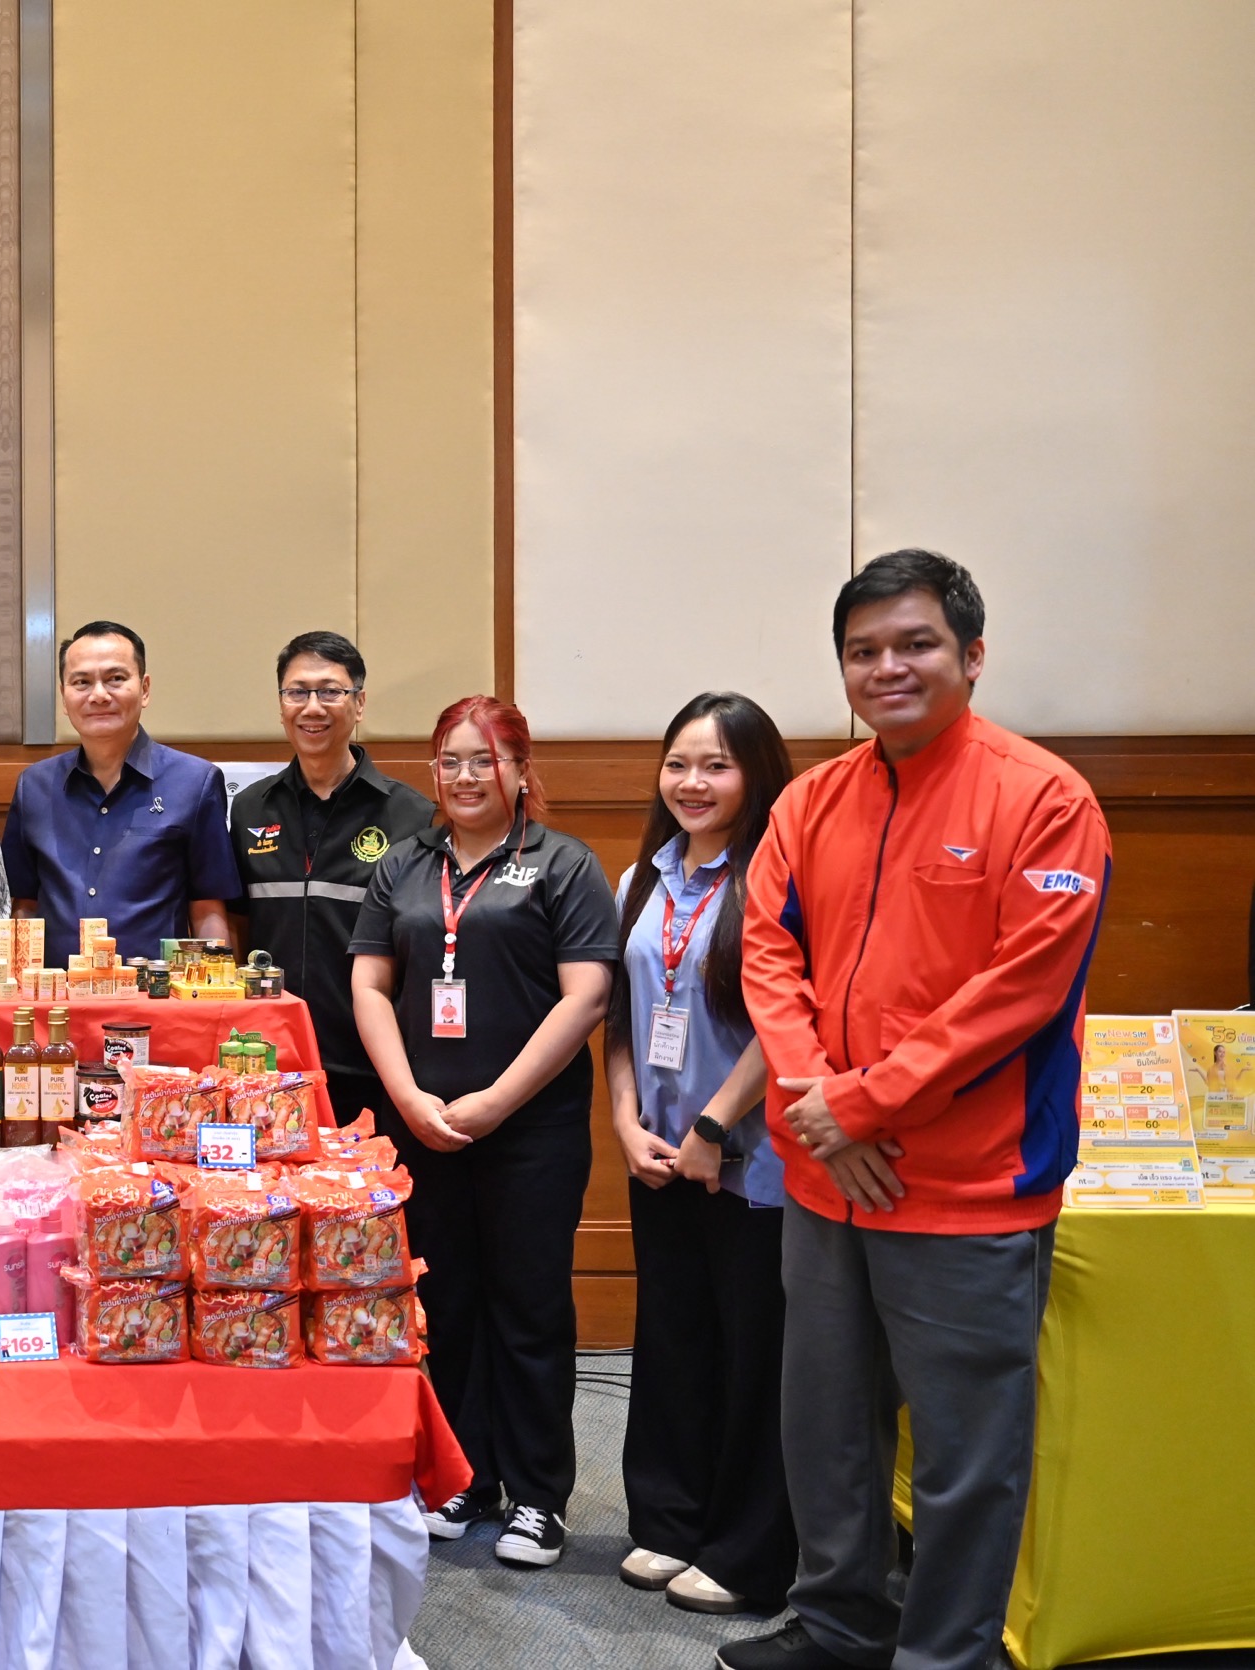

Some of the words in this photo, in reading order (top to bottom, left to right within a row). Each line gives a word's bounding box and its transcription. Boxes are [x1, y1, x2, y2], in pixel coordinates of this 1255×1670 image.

[1043, 873, 1080, 893] EMS
[1094, 1031, 1106, 1039] my
[1107, 1029, 1130, 1038] New
[1212, 1026, 1236, 1043] 5G
[1101, 1075, 1108, 1083] 4
[1155, 1075, 1162, 1084] 4
[12, 1082, 31, 1090] HONEY
[48, 1083, 66, 1091] HONEY
[1104, 1109, 1115, 1118] 10
[1156, 1110, 1169, 1119] 20
[1092, 1120, 1105, 1128] 40
[1145, 1120, 1159, 1128] 60
[210, 1145, 234, 1160] 32
